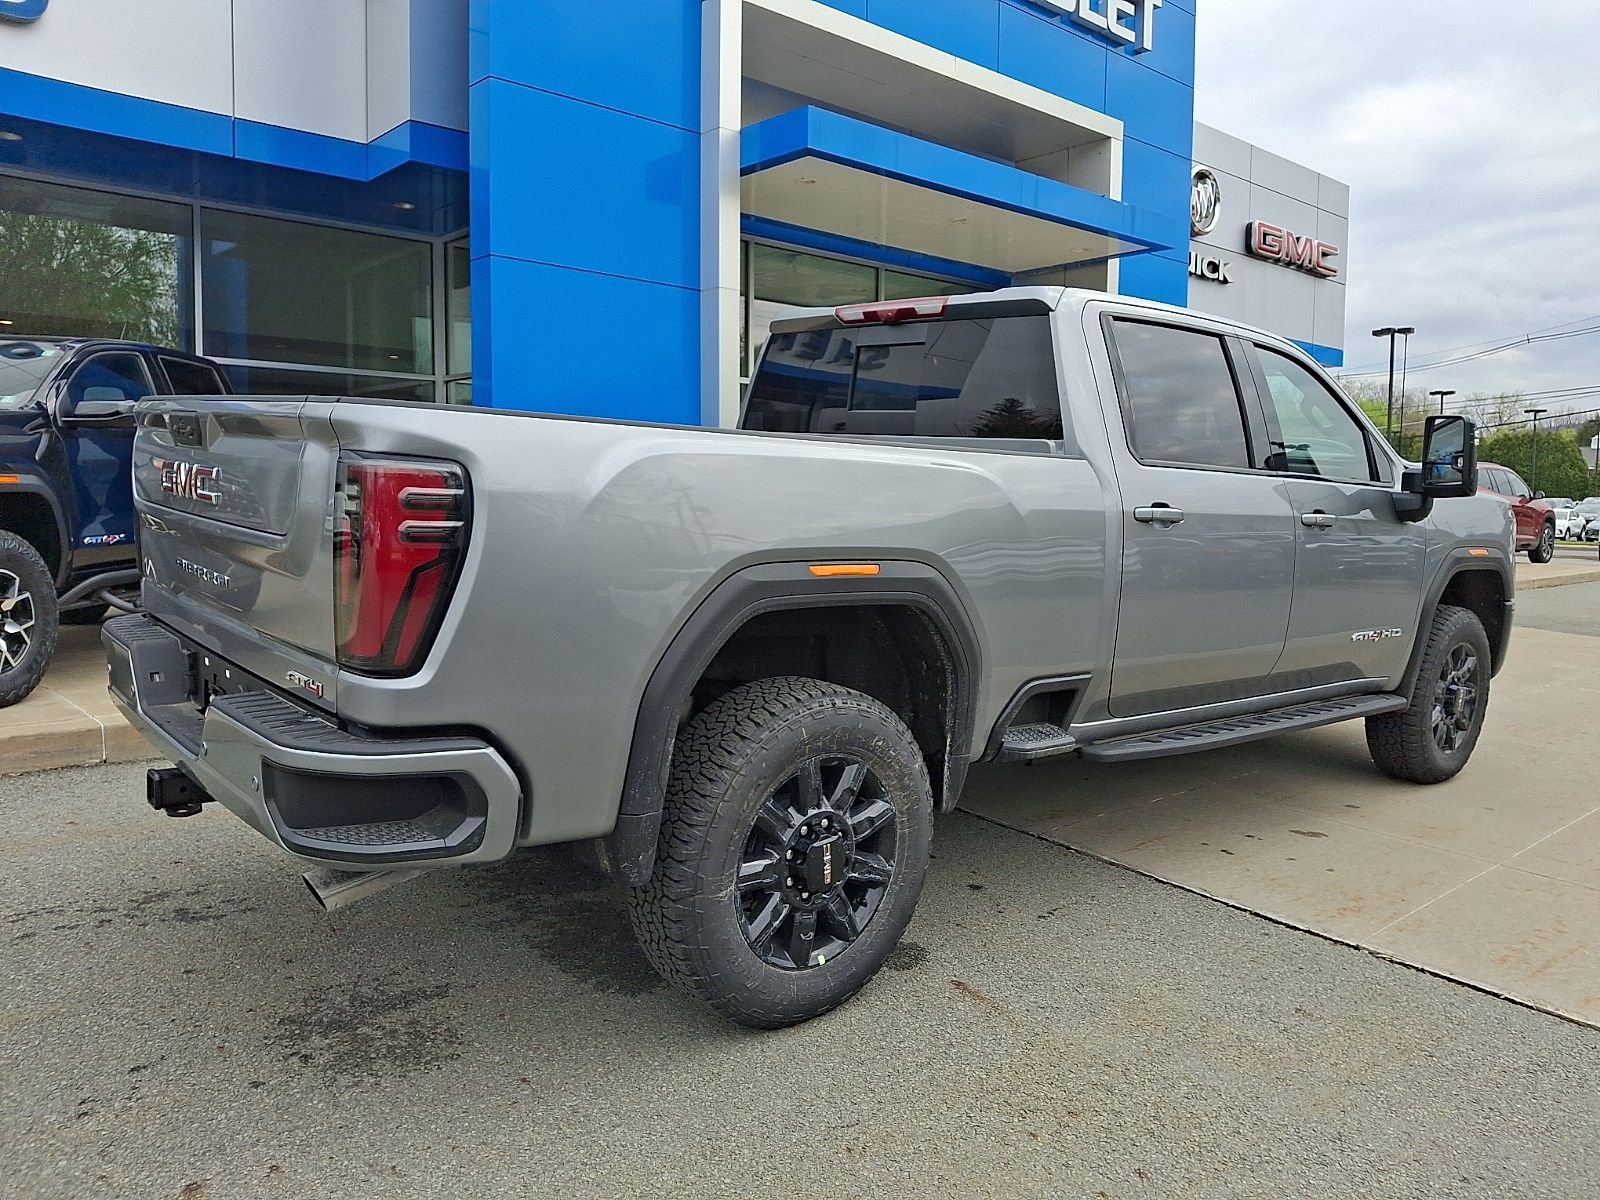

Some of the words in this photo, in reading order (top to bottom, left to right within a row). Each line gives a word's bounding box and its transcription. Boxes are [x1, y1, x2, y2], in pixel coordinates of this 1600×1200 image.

[1252, 220, 1339, 277] GMC
[153, 457, 222, 505] GMC
[285, 670, 323, 699] AT4
[823, 843, 832, 885] GMC
